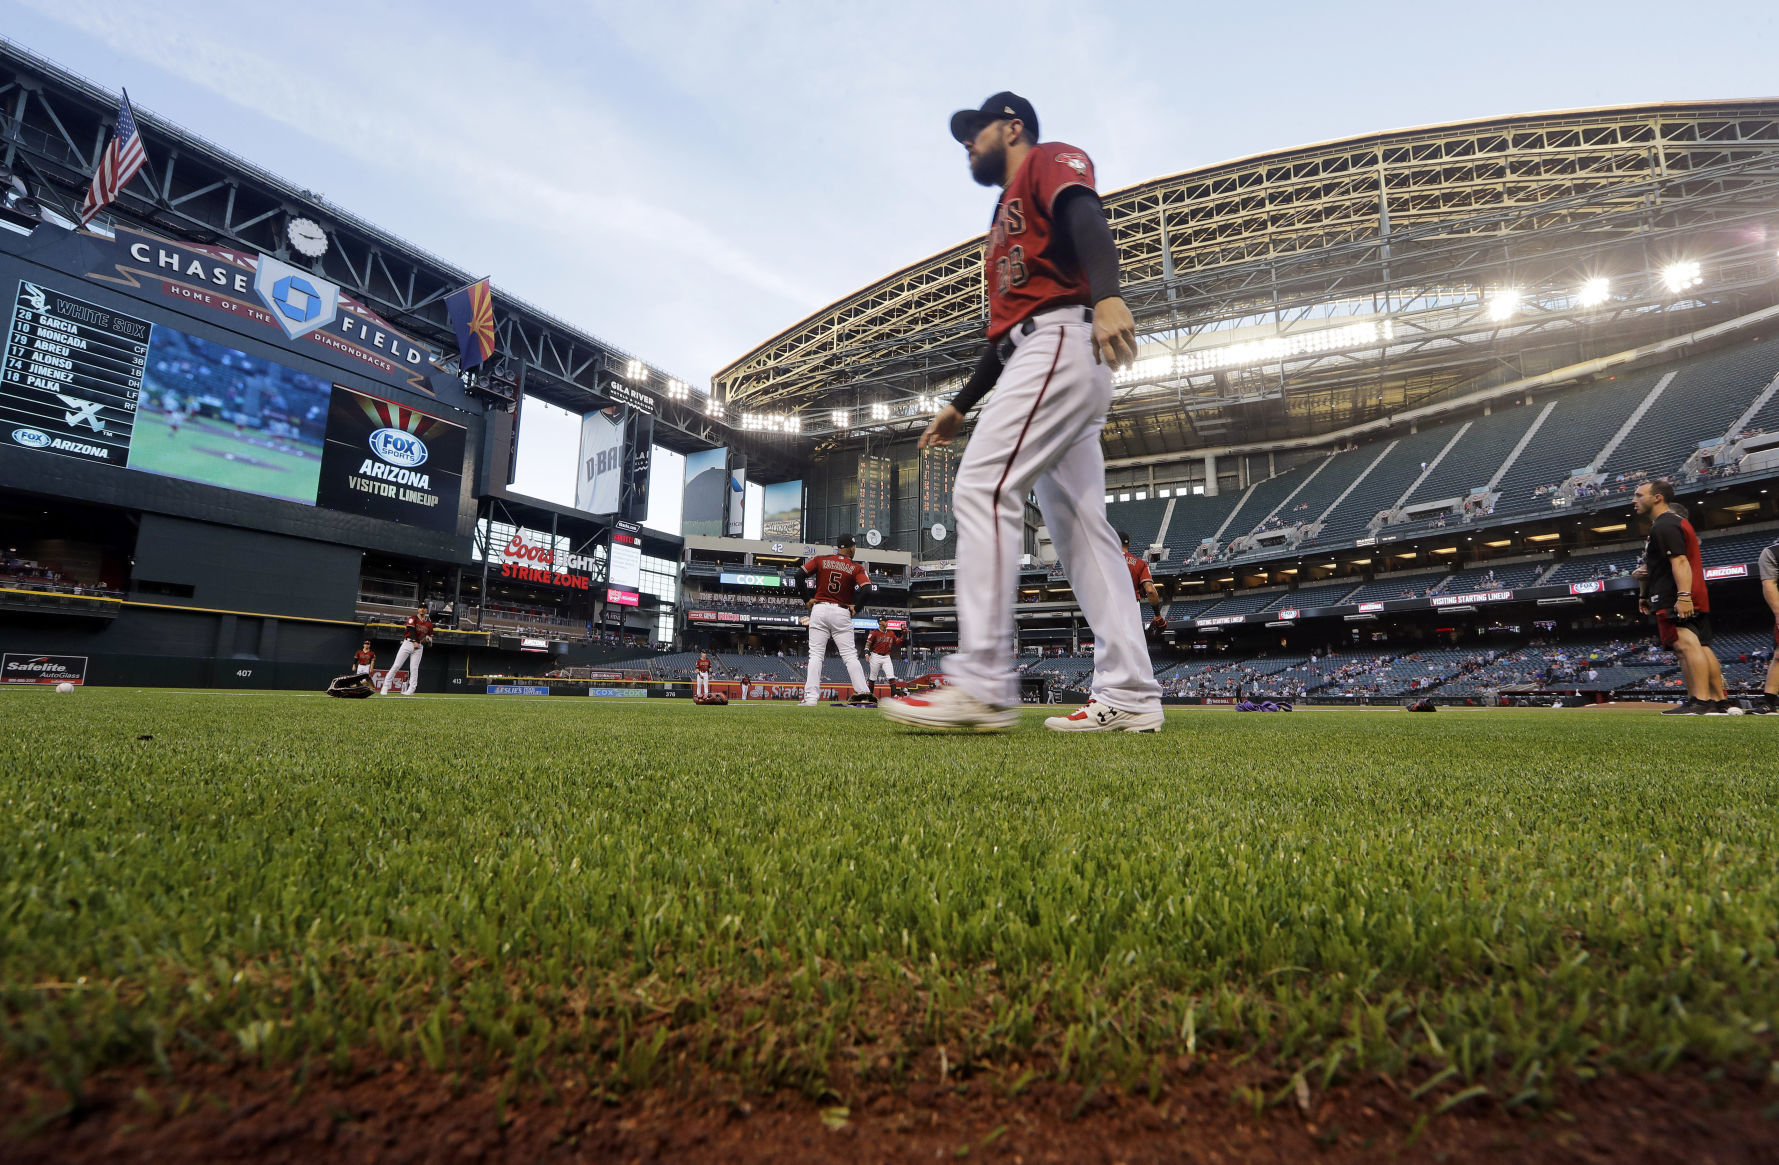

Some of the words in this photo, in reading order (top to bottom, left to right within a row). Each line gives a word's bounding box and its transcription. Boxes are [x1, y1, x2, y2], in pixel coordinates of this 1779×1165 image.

[130, 242, 248, 294] CHASE
[56, 299, 110, 328] WHITE
[112, 317, 146, 339] SOX
[170, 285, 212, 304] HOME
[221, 301, 238, 312] OF
[247, 309, 272, 324] THE
[16, 321, 31, 333] 10
[37, 327, 87, 350] MONCADA
[131, 356, 144, 366] 3B
[18, 309, 33, 321] 28
[39, 315, 78, 335] GARCIA
[134, 345, 147, 355] CF
[341, 317, 422, 365] FIELD
[11, 345, 26, 357] 17
[31, 351, 73, 370] ALONSO
[128, 379, 141, 389] DH
[13, 333, 28, 345] 79
[34, 340, 70, 357] ABREU
[130, 368, 142, 377] 1B
[314, 333, 392, 372] DIAMONDBACKS
[6, 370, 20, 382] 18
[26, 375, 60, 393] PALKA
[124, 401, 137, 411] RF
[8, 358, 23, 370] 74
[28, 363, 75, 383] JIMENEZ
[126, 390, 138, 400] LF
[611, 381, 630, 396] GILA
[631, 389, 654, 406] RIVER
[21, 432, 43, 442] FOX
[50, 438, 109, 459] ARIZONA
[381, 447, 415, 462] SPORTS
[382, 433, 416, 456] FOX
[358, 458, 430, 490] ARIZONA
[348, 475, 397, 498] VISITOR
[399, 487, 439, 507] LINEUP
[504, 535, 554, 564] Coors
[555, 551, 595, 572] LIGHT
[771, 543, 783, 553] 42
[501, 562, 551, 584] STRIKE
[553, 571, 589, 590] ZONE
[736, 574, 765, 586] COX
[828, 571, 843, 594] 5
[1706, 566, 1745, 578] ARIZONA
[1432, 596, 1457, 605] VISITING
[1458, 593, 1487, 604] STARTING
[1488, 591, 1511, 600] LINEUP
[1196, 618, 1212, 626] VISITING
[1212, 617, 1231, 625] STARTING
[7, 662, 67, 672] Safelite
[236, 669, 252, 677] 407
[771, 685, 805, 698] State
